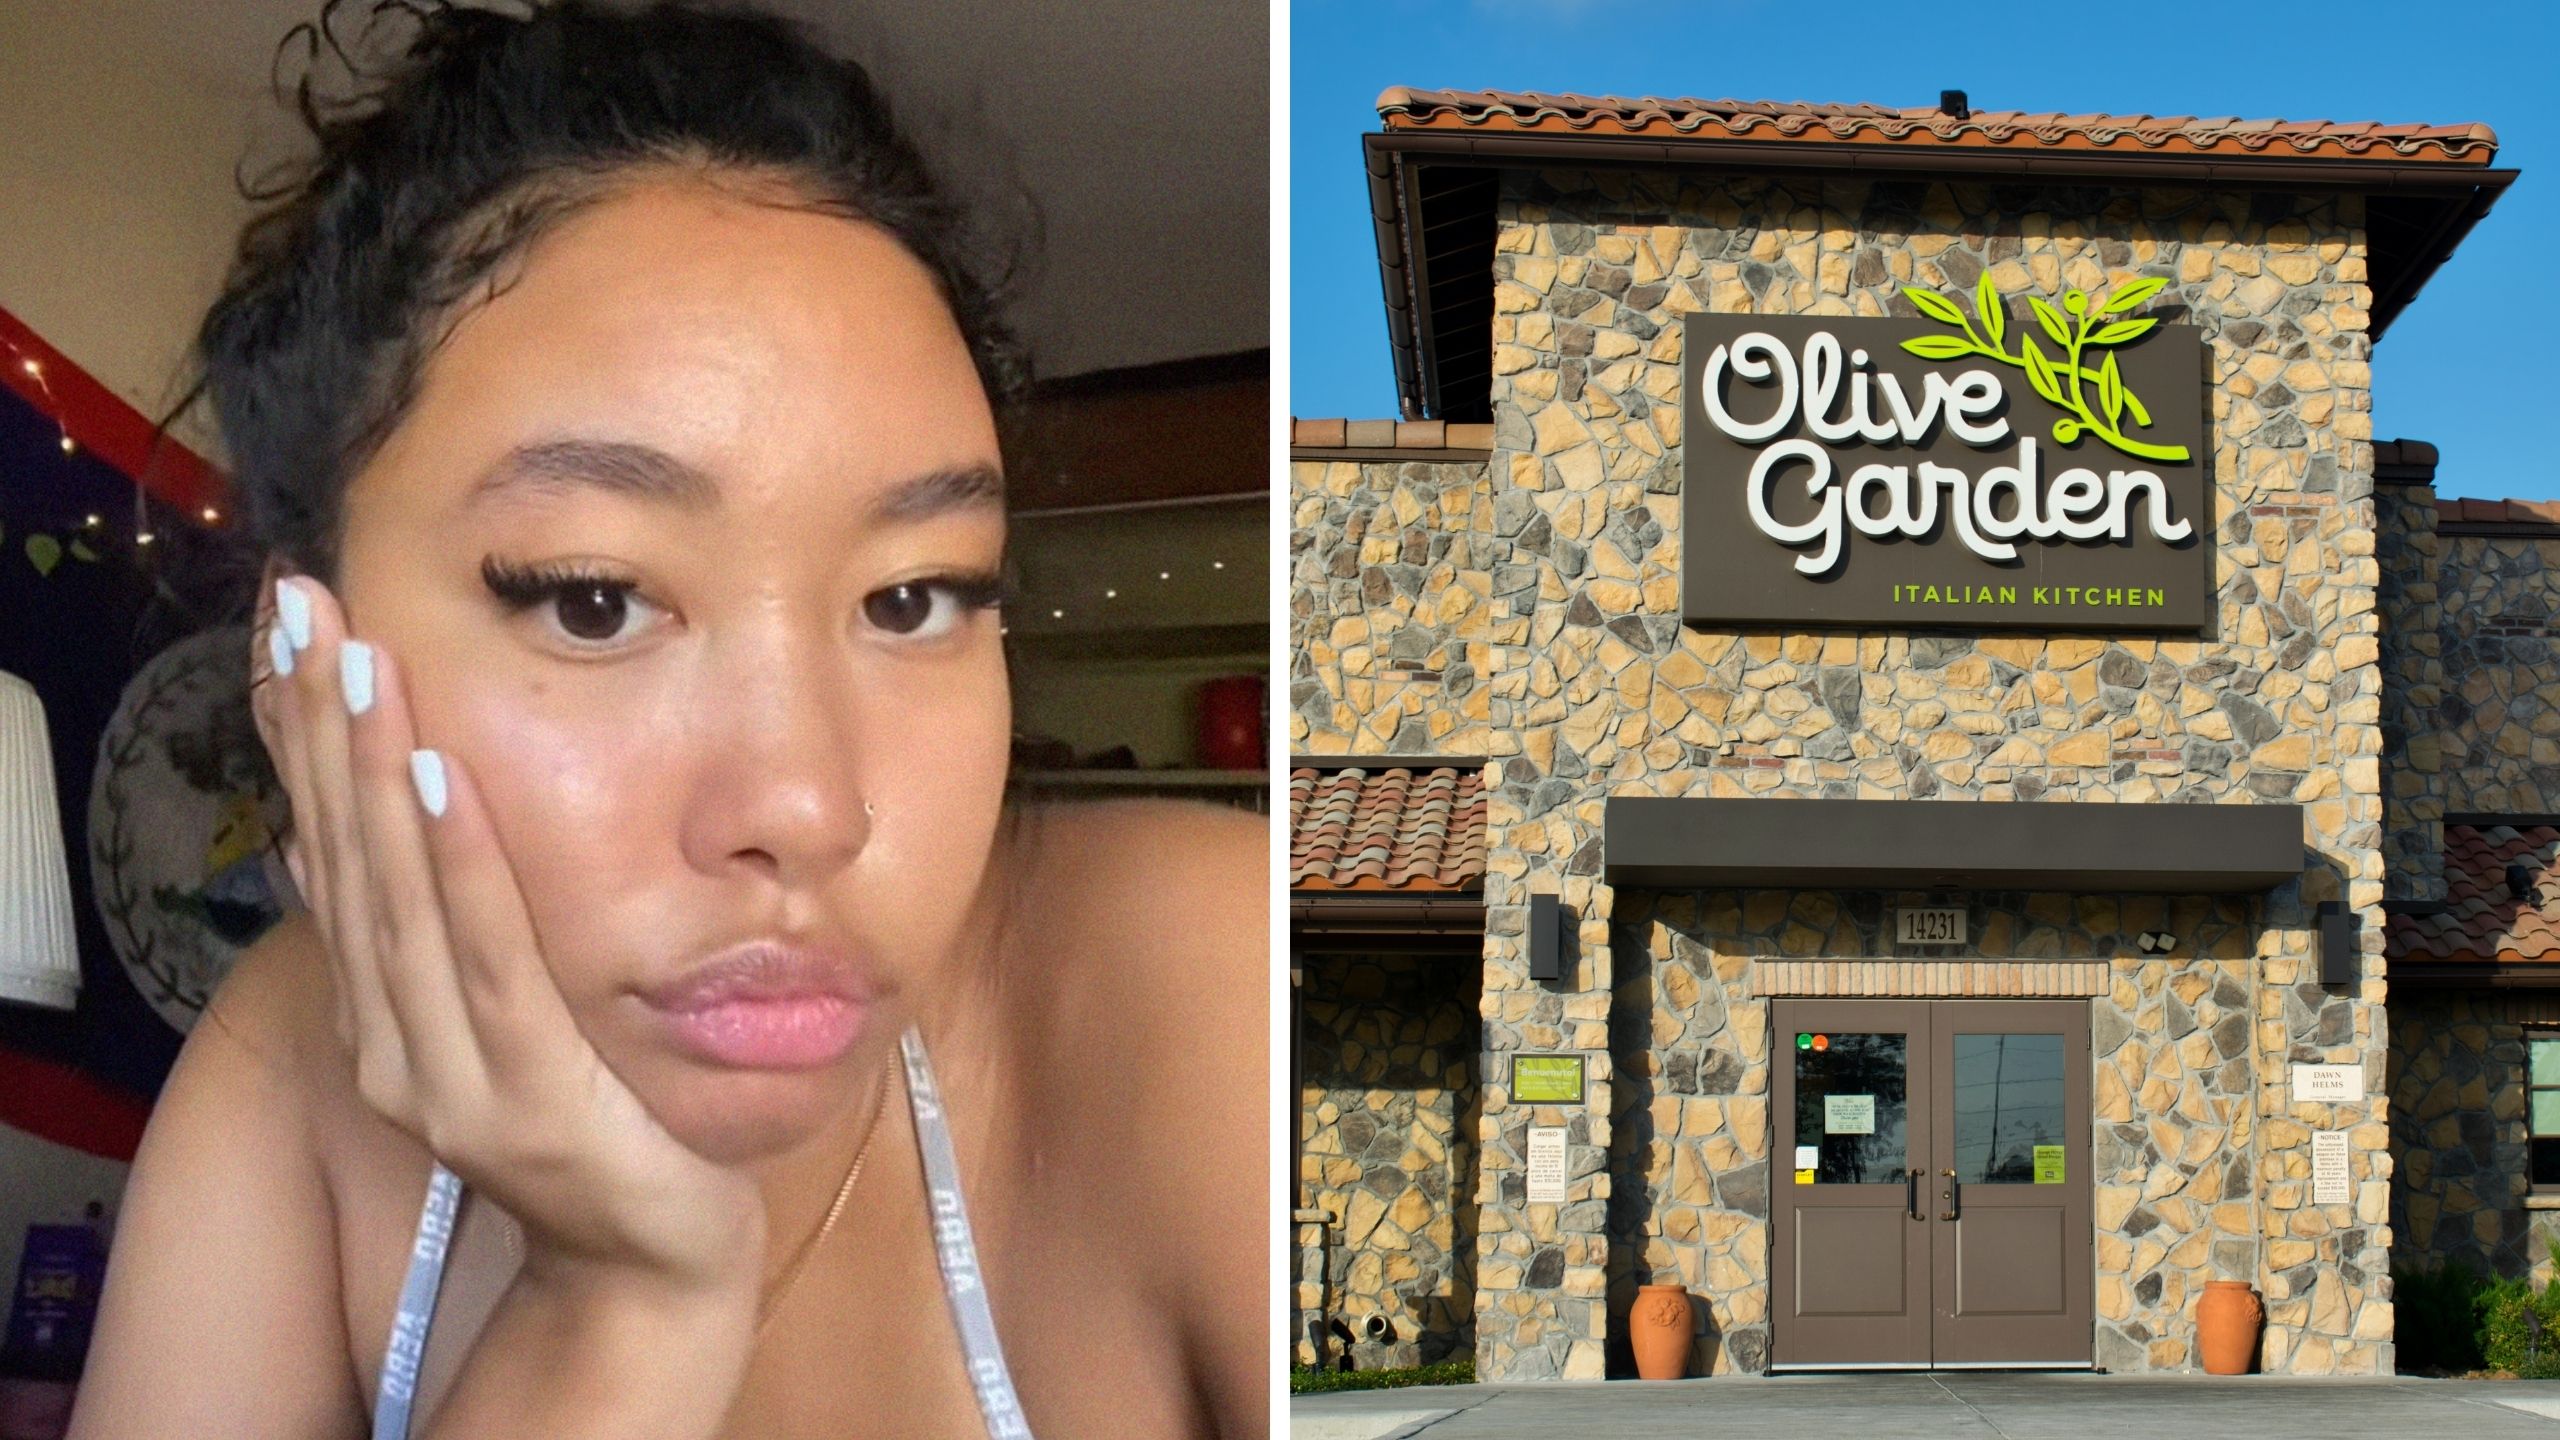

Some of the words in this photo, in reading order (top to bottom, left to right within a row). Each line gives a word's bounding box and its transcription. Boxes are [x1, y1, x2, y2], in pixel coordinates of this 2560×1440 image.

[1703, 331, 2010, 447] Olive
[1747, 437, 2192, 577] Garden
[1894, 584, 2017, 605] ITALIAN
[2033, 586, 2165, 607] KITCHEN
[1906, 911, 1957, 940] 14231
[2313, 1071, 2342, 1079] DAWN
